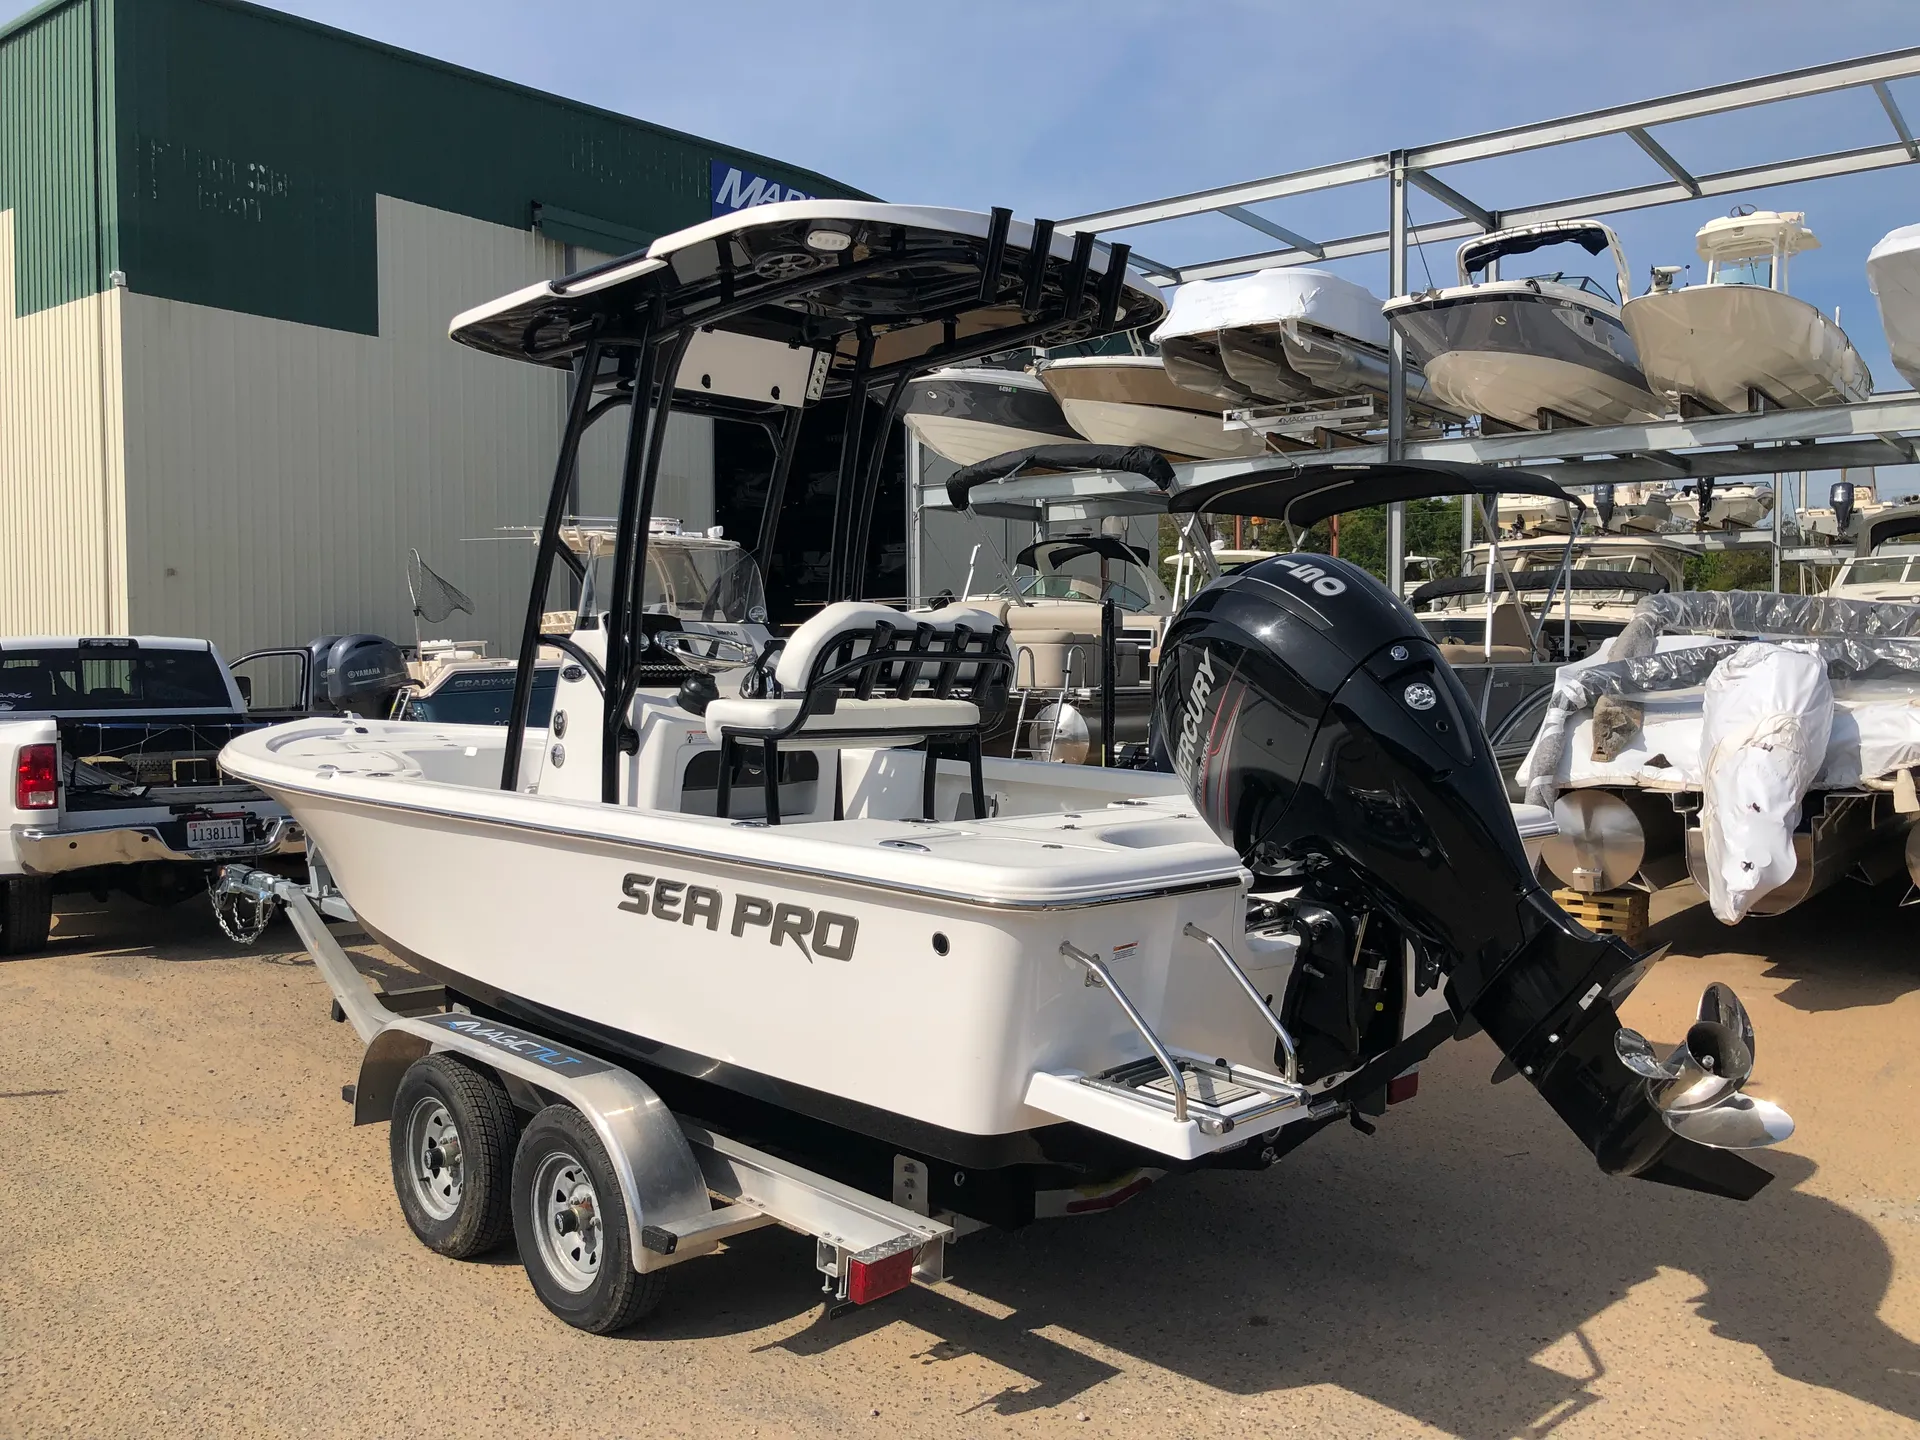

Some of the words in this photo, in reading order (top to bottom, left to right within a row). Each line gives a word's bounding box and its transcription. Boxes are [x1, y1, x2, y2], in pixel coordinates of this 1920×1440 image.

[1273, 559, 1347, 597] 150
[354, 667, 381, 677] YAMAHA
[192, 826, 240, 842] 1138111
[617, 872, 723, 932] SEA
[731, 893, 860, 964] PRO
